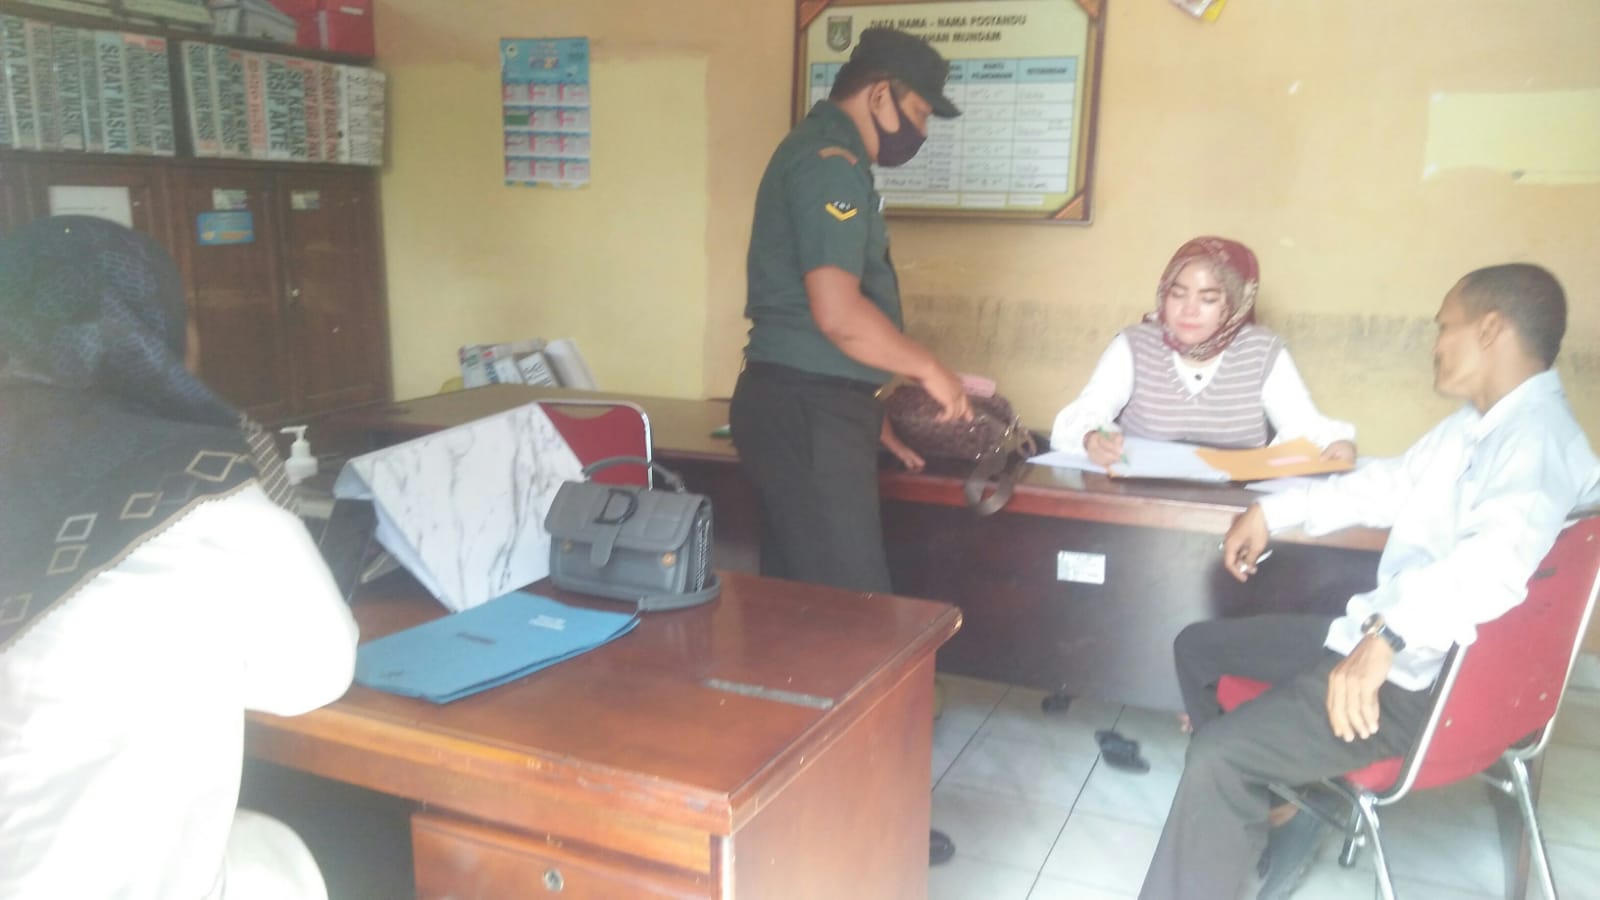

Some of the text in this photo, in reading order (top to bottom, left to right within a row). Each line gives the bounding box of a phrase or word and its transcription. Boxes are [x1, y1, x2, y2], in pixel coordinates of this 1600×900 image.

[898, 18, 926, 28] NAMA
[937, 17, 966, 27] NAMA
[101, 44, 131, 150] SURAT MASUK
[266, 61, 286, 104] ARSIP
[592, 487, 639, 526] D
